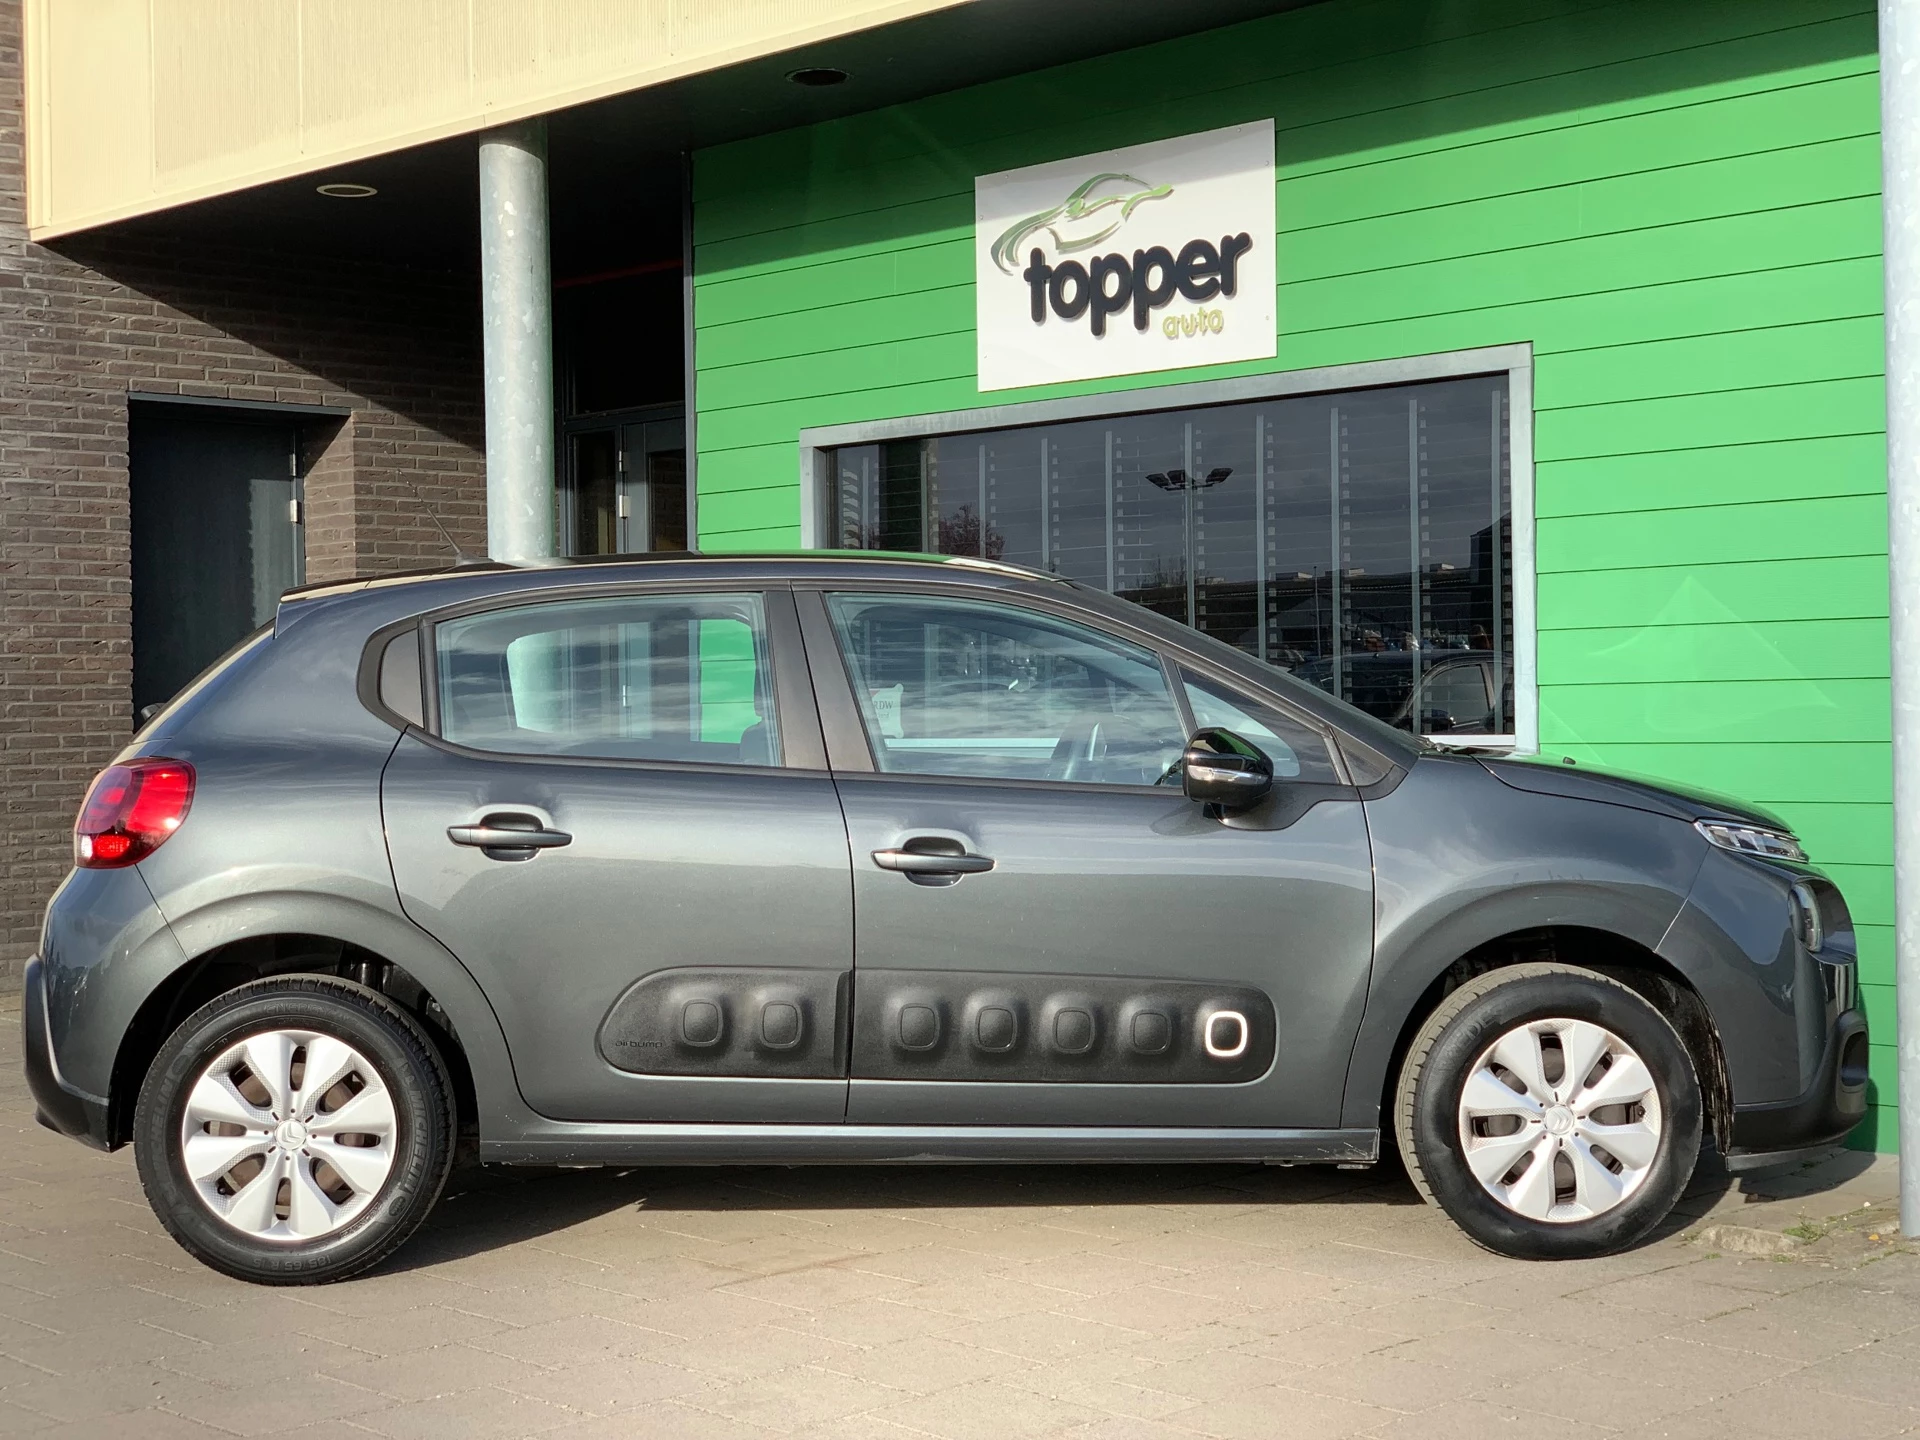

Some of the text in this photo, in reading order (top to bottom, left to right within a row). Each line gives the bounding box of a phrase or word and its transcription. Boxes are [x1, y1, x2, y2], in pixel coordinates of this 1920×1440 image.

[1023, 232, 1253, 337] topper
[1162, 306, 1224, 339] auto
[615, 1039, 663, 1049] airbump
[403, 1090, 429, 1194] MICHELIN
